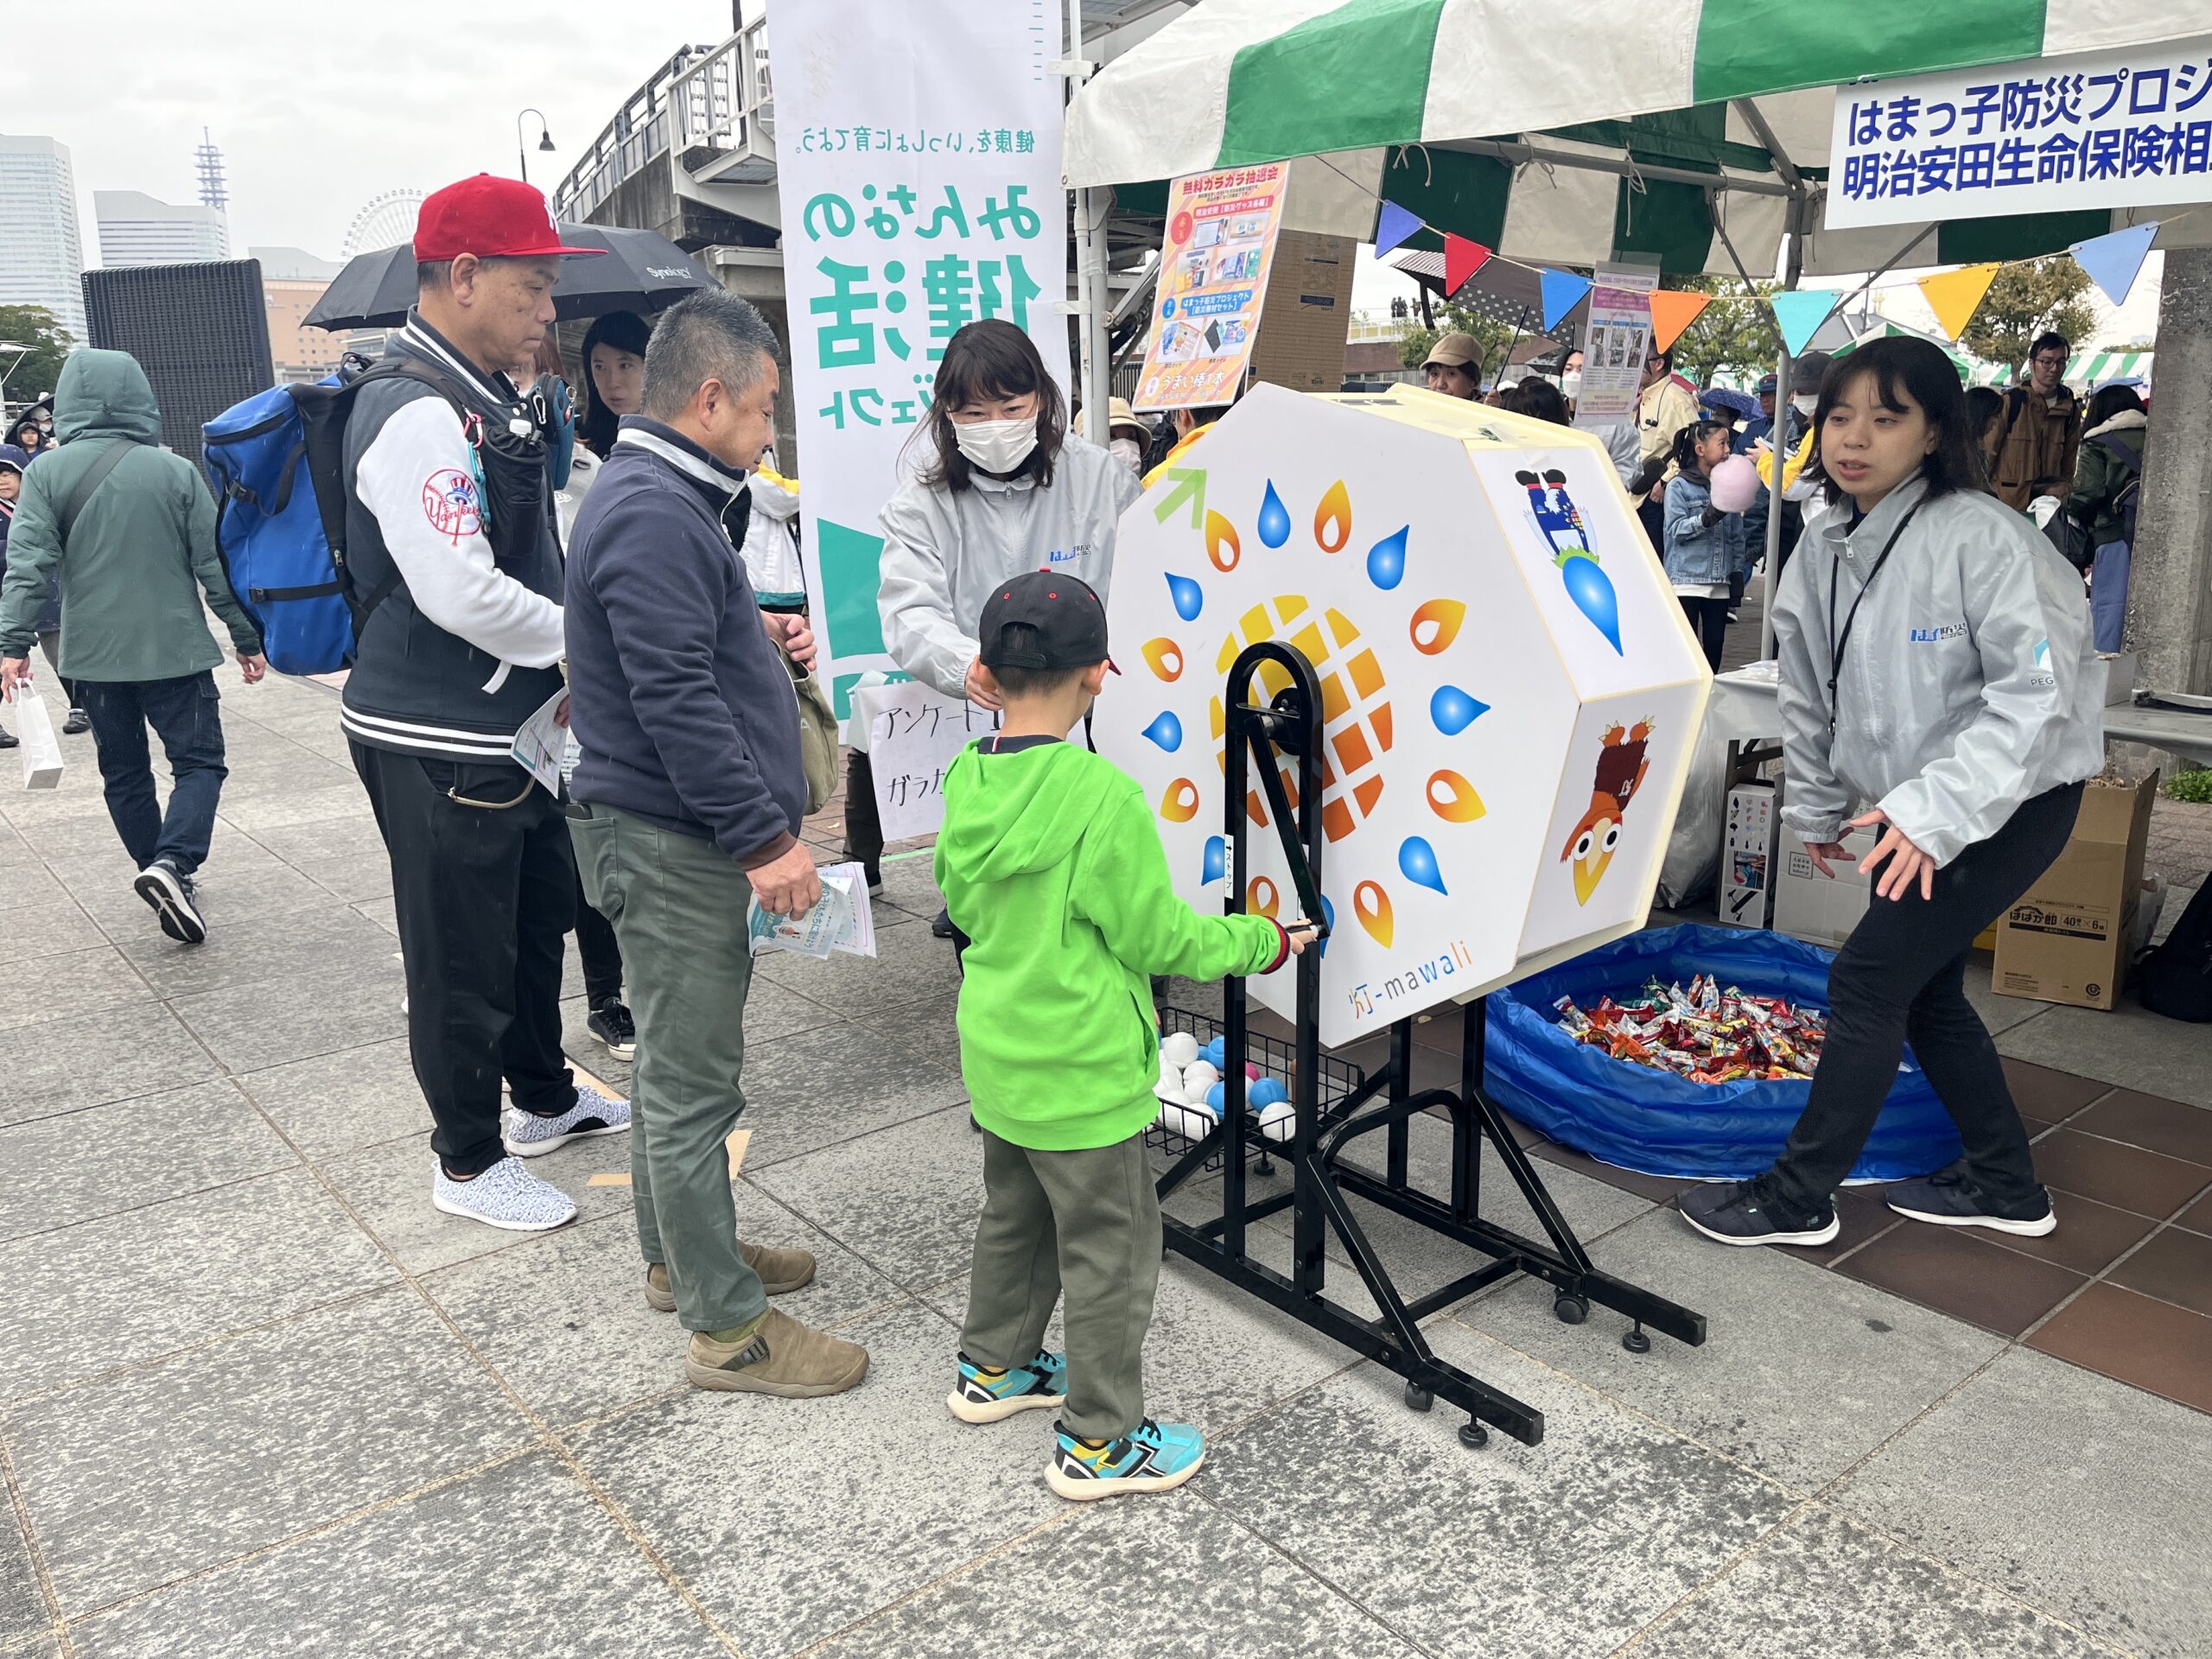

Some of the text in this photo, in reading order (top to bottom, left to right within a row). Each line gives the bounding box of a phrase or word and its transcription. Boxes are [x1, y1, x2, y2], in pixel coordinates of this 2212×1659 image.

[1842, 120, 2212, 201] 明治安田生命保険相
